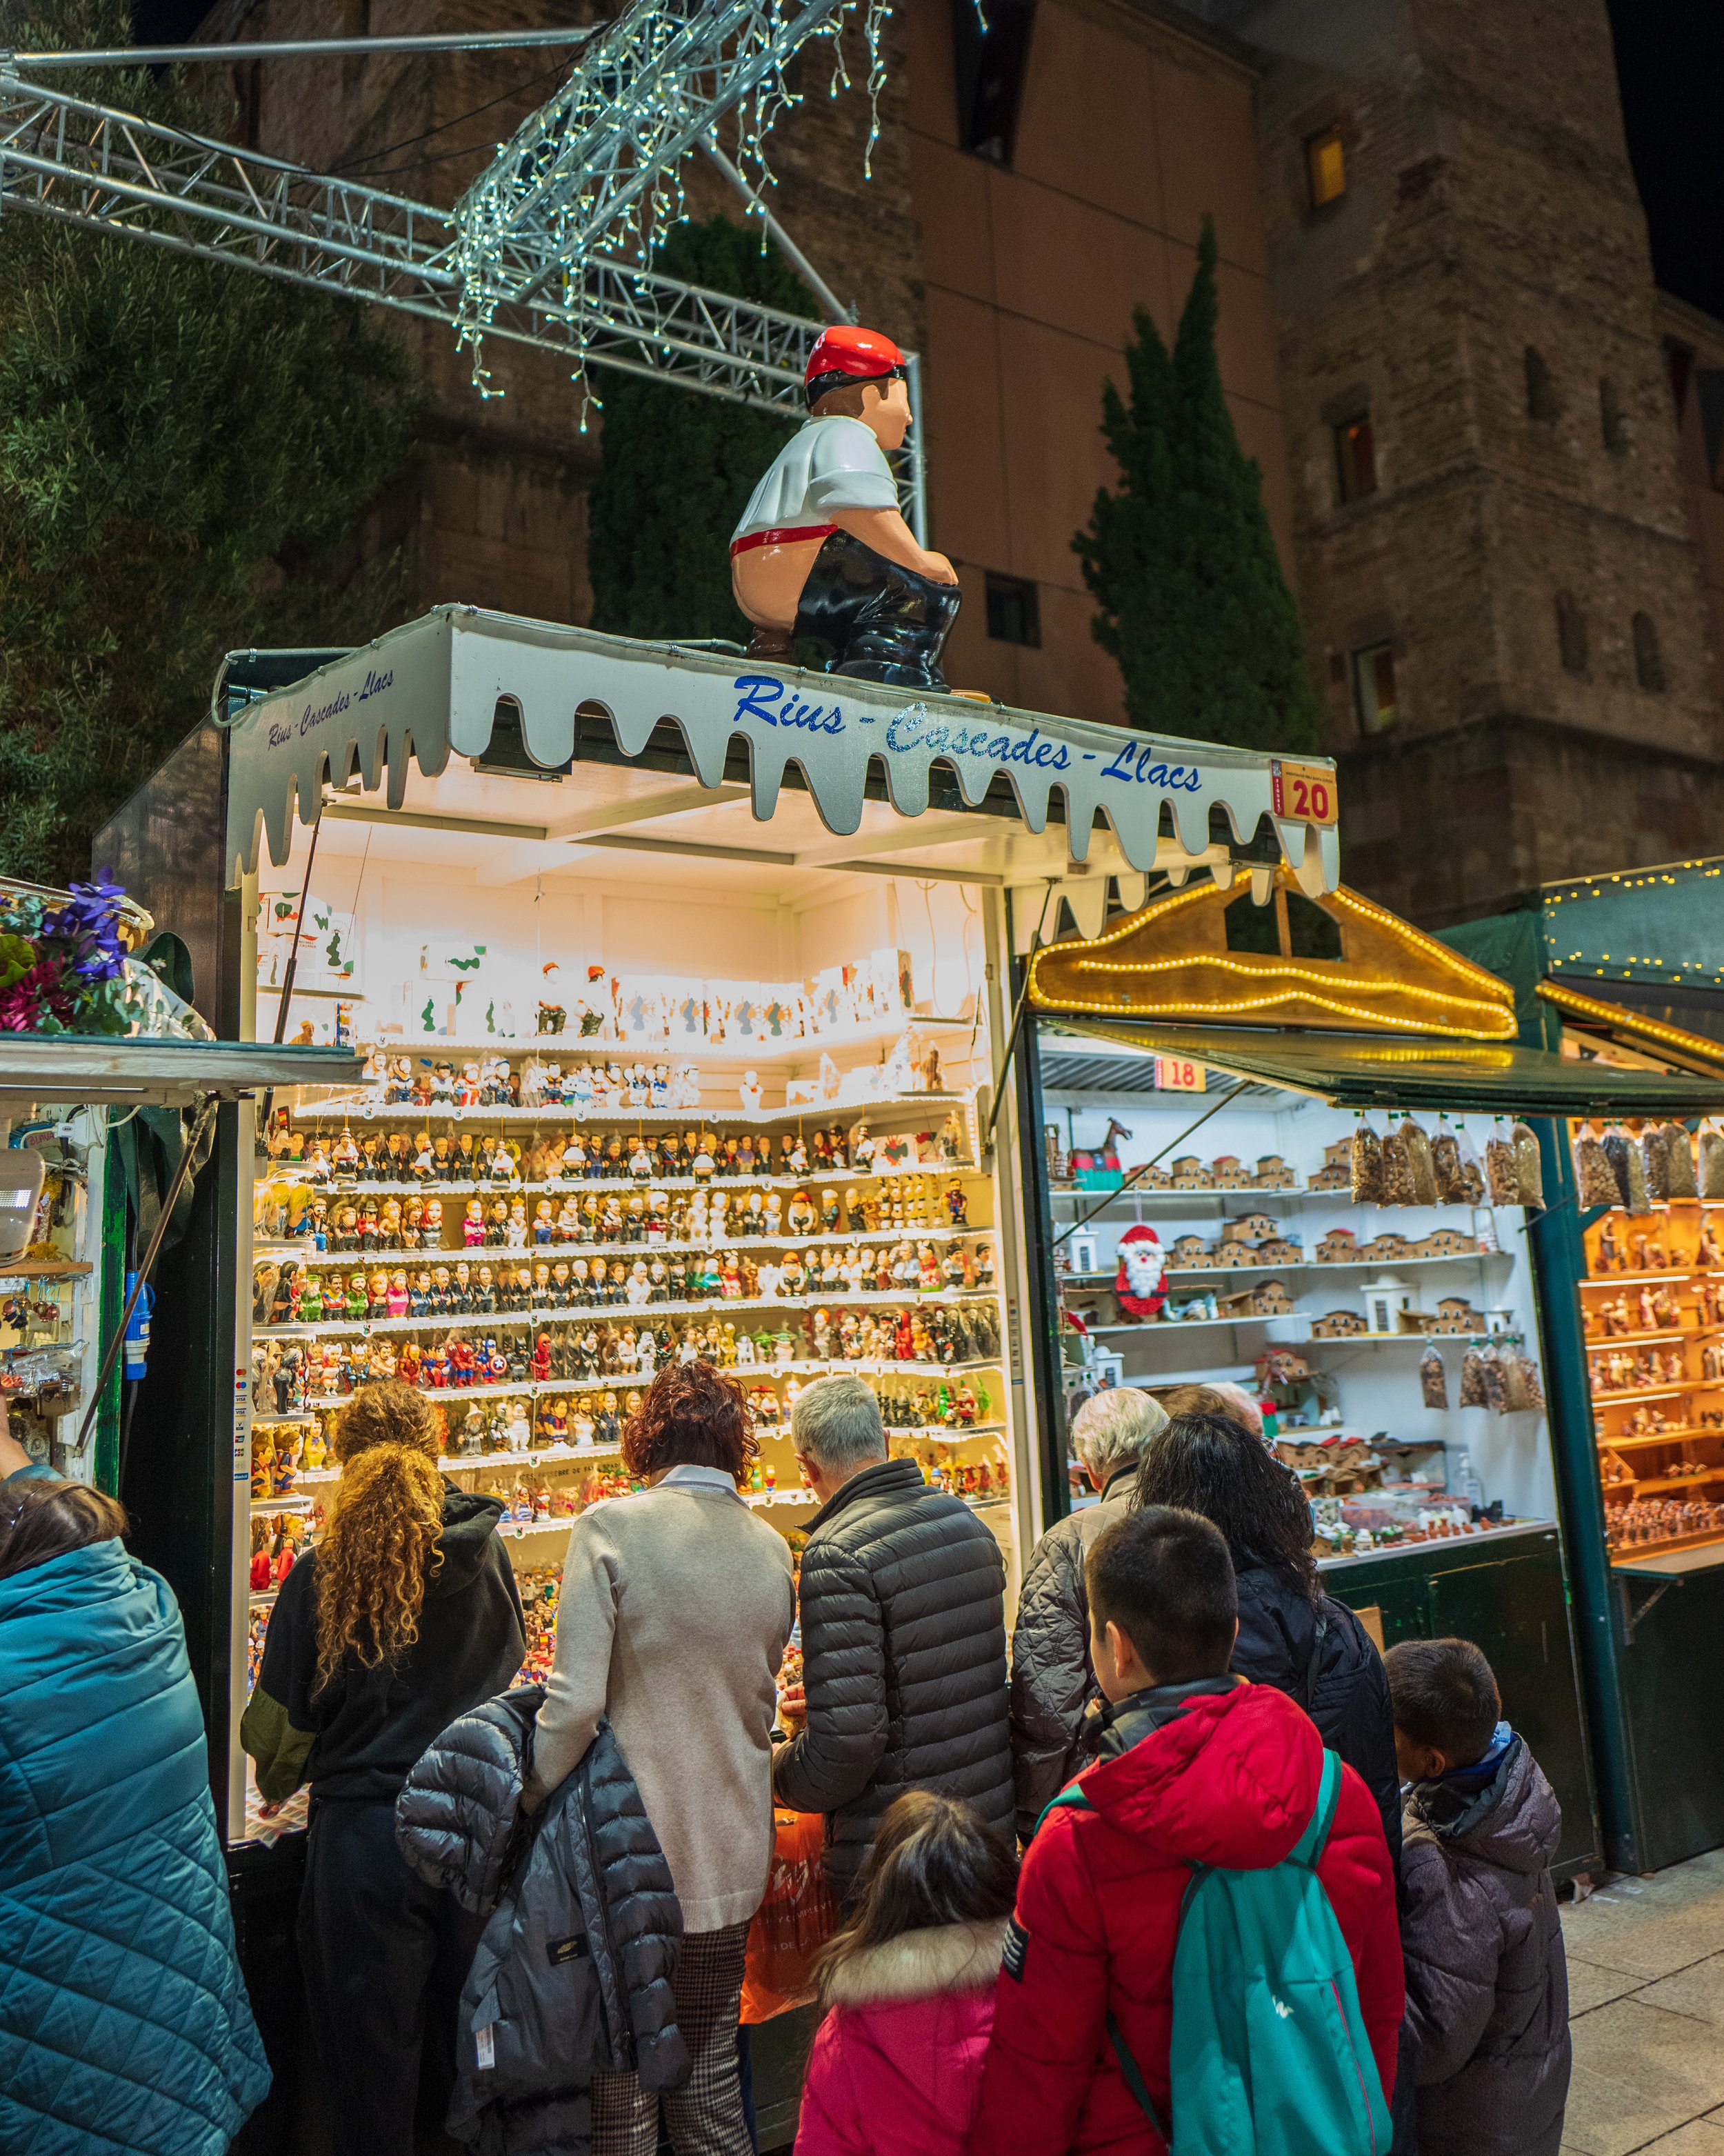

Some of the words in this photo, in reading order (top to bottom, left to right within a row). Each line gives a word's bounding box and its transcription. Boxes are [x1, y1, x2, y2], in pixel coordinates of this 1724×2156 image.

[268, 723, 292, 751] Rius
[300, 690, 350, 737] Cascades
[359, 670, 394, 702] Llacs
[733, 675, 846, 735] Rius
[886, 701, 1071, 770] Cascades
[1101, 741, 1202, 792] Llacs
[1293, 779, 1329, 819] 20
[1172, 1061, 1194, 1086] 18
